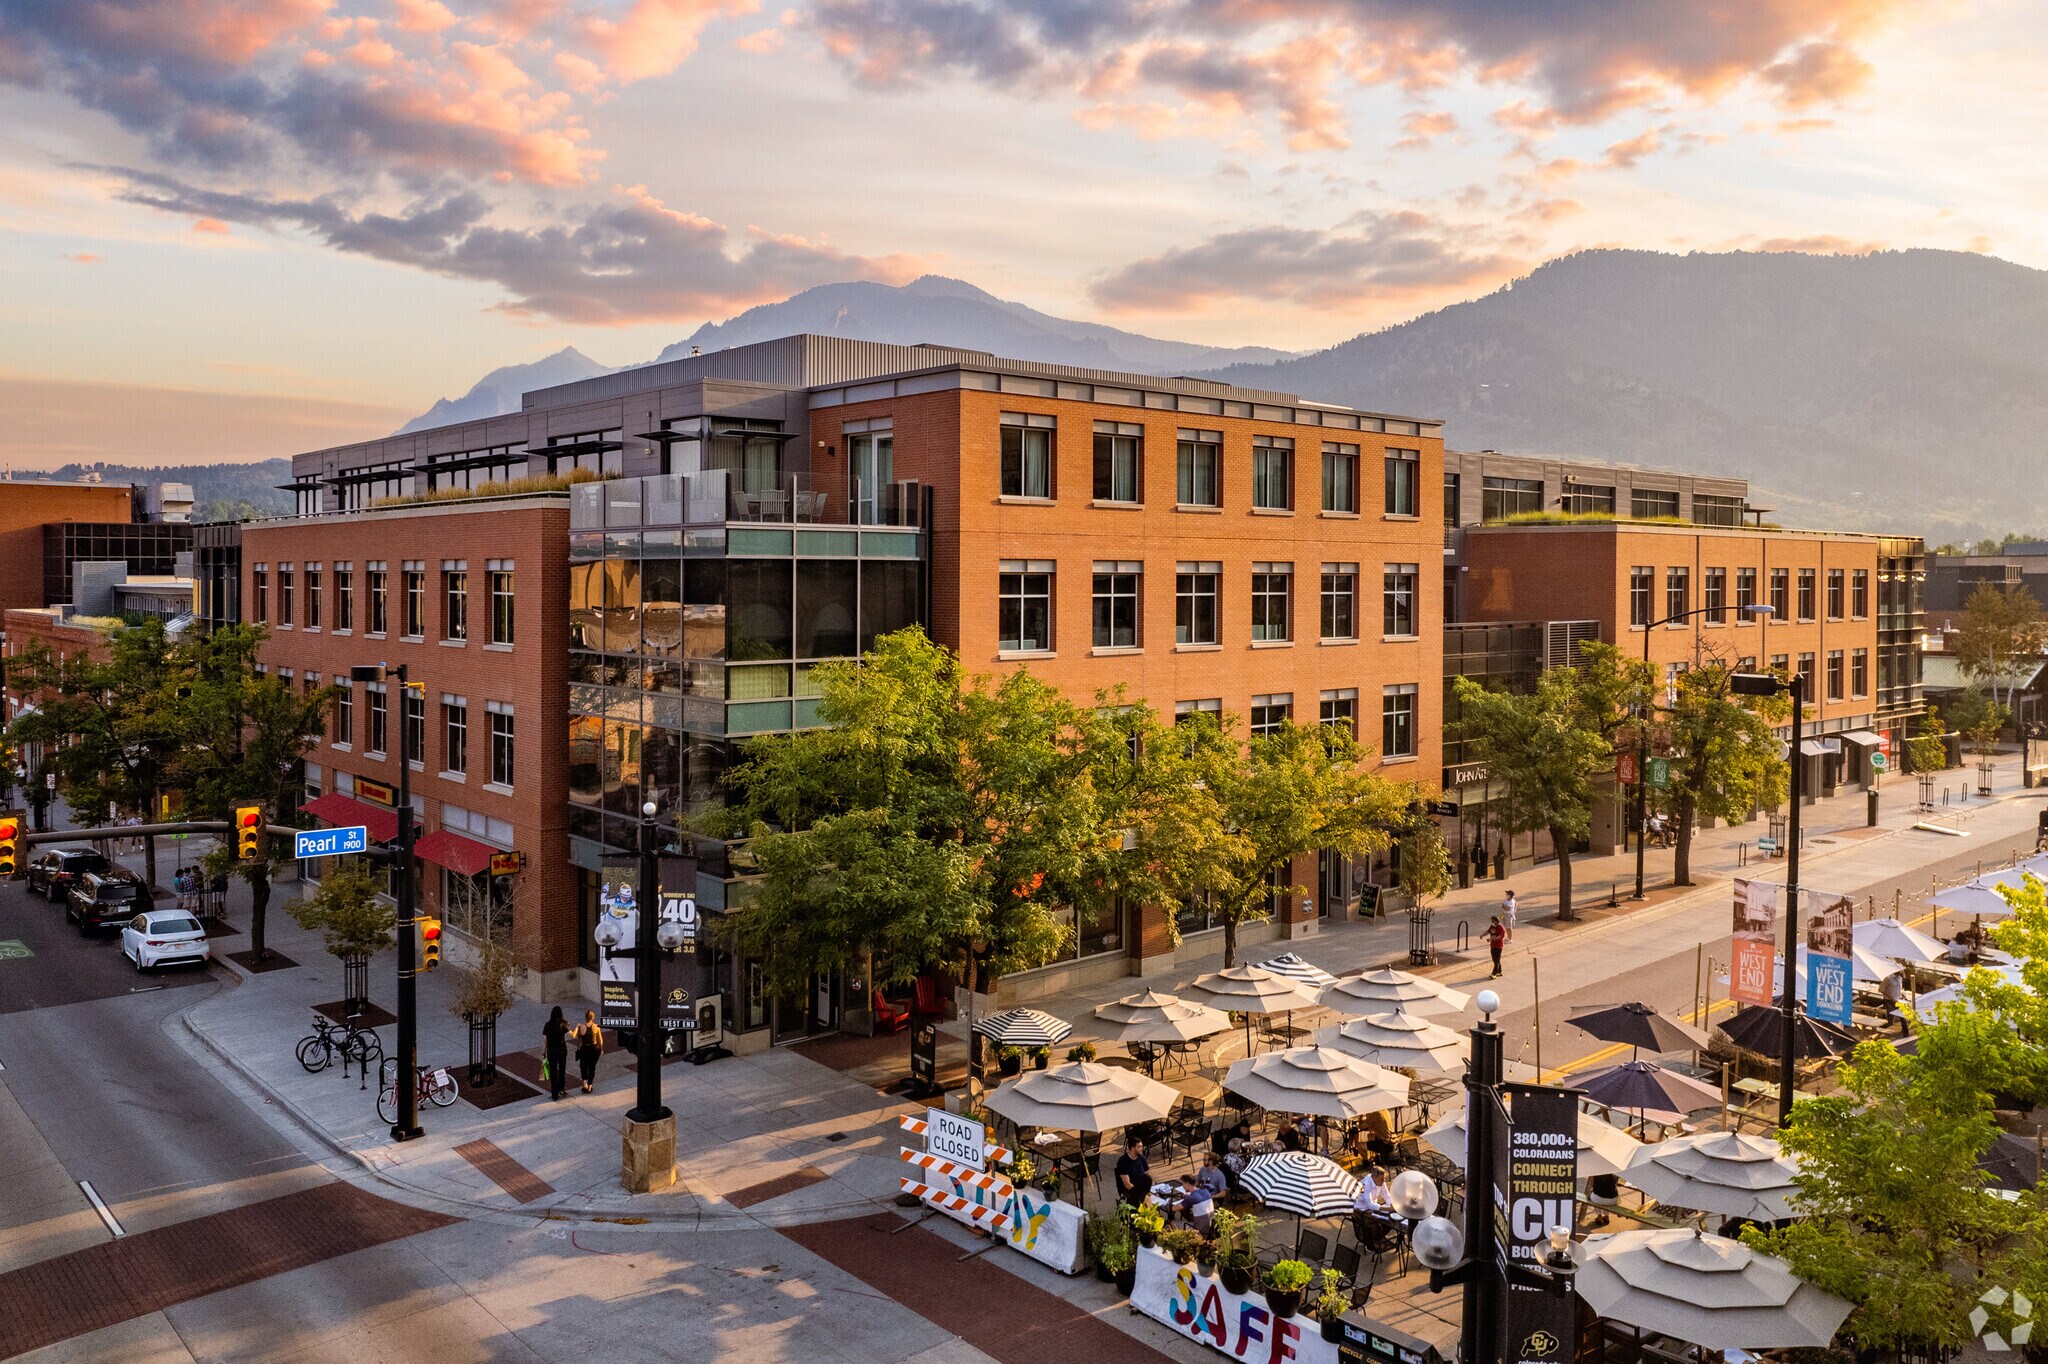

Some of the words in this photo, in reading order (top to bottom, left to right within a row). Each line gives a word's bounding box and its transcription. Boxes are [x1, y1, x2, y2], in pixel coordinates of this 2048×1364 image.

[1455, 769, 1475, 785] JOHN
[299, 835, 336, 853] Pearl
[348, 831, 357, 839] St
[343, 840, 361, 849] 1900
[662, 899, 695, 923] 40
[1739, 951, 1767, 971] WEST
[1739, 966, 1765, 988] END
[1816, 966, 1846, 987] WEST
[1817, 982, 1844, 1004] END
[602, 1018, 635, 1026] DOWNTOWN
[940, 1118, 972, 1141] ROAD
[934, 1136, 979, 1162] CLOSED
[1513, 1133, 1574, 1147] 380,000+
[1513, 1149, 1574, 1159] COLORADANS
[1513, 1163, 1574, 1177] CONNECT
[1512, 1180, 1574, 1194] THROUGH
[1512, 1197, 1573, 1241] CU
[1340, 1345, 1364, 1360] RECYCLE
